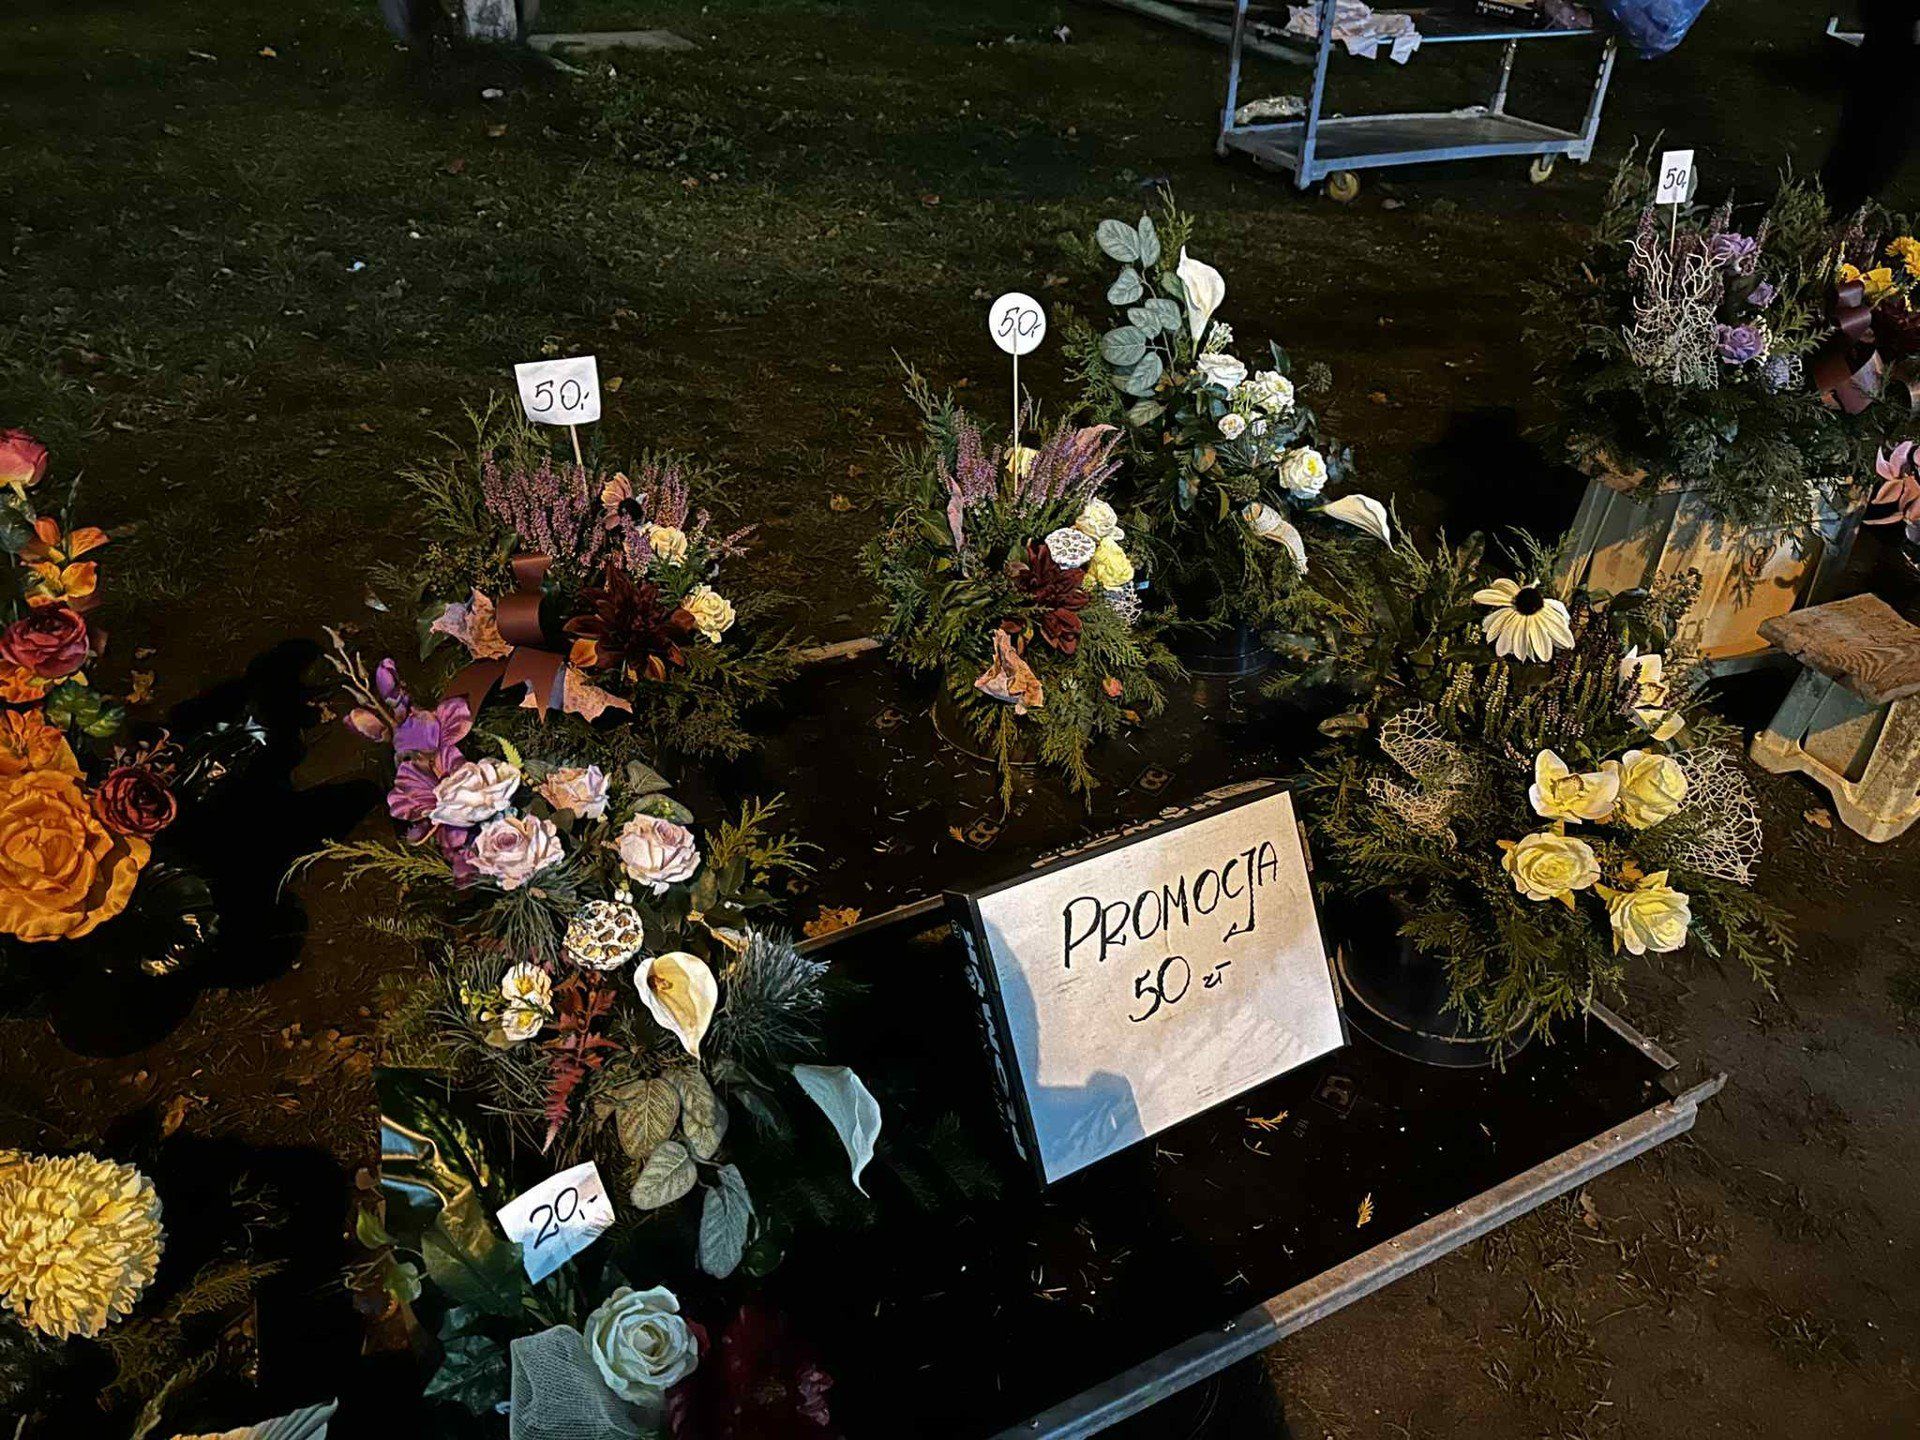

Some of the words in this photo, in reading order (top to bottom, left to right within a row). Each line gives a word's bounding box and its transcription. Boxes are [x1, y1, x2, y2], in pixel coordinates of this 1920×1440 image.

[997, 306, 1042, 338] 50,-
[532, 379, 590, 412] 50,-
[1062, 841, 1278, 969] PROMOCJA
[1128, 955, 1191, 1023] 50
[529, 1187, 598, 1250] 20,-
